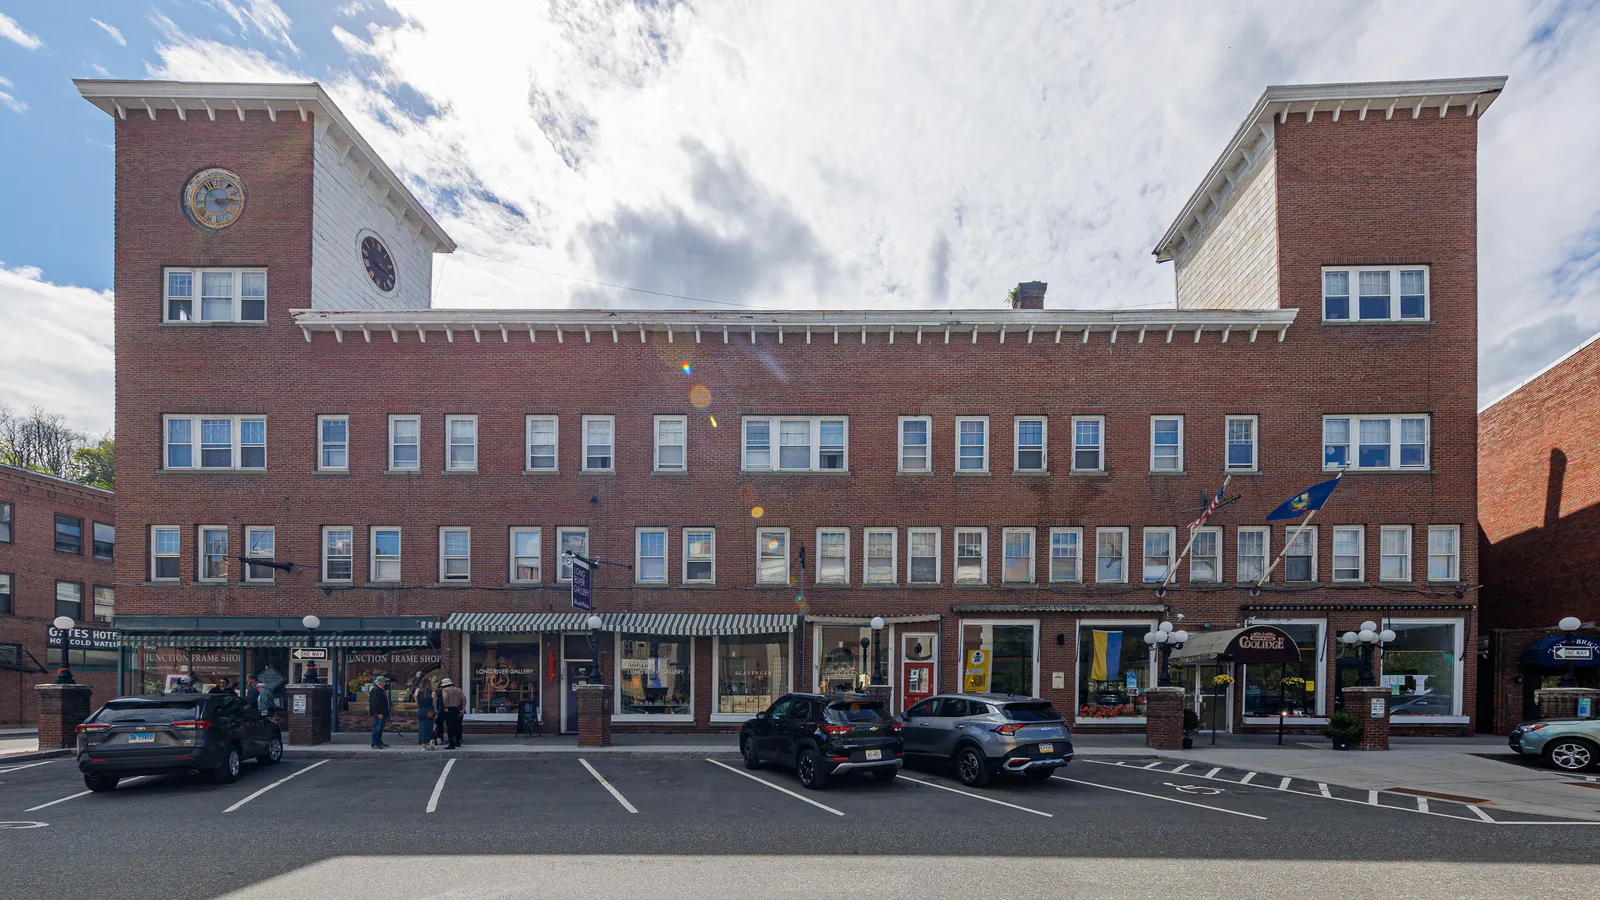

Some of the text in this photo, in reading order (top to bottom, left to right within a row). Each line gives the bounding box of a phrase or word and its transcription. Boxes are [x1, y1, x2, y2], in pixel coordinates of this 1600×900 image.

[1239, 635, 1285, 650] COOLIDGE
[145, 653, 189, 663] JUNCTION
[191, 653, 219, 662] FRAME
[346, 654, 388, 664] JUNCTION
[391, 654, 419, 663] FRAME
